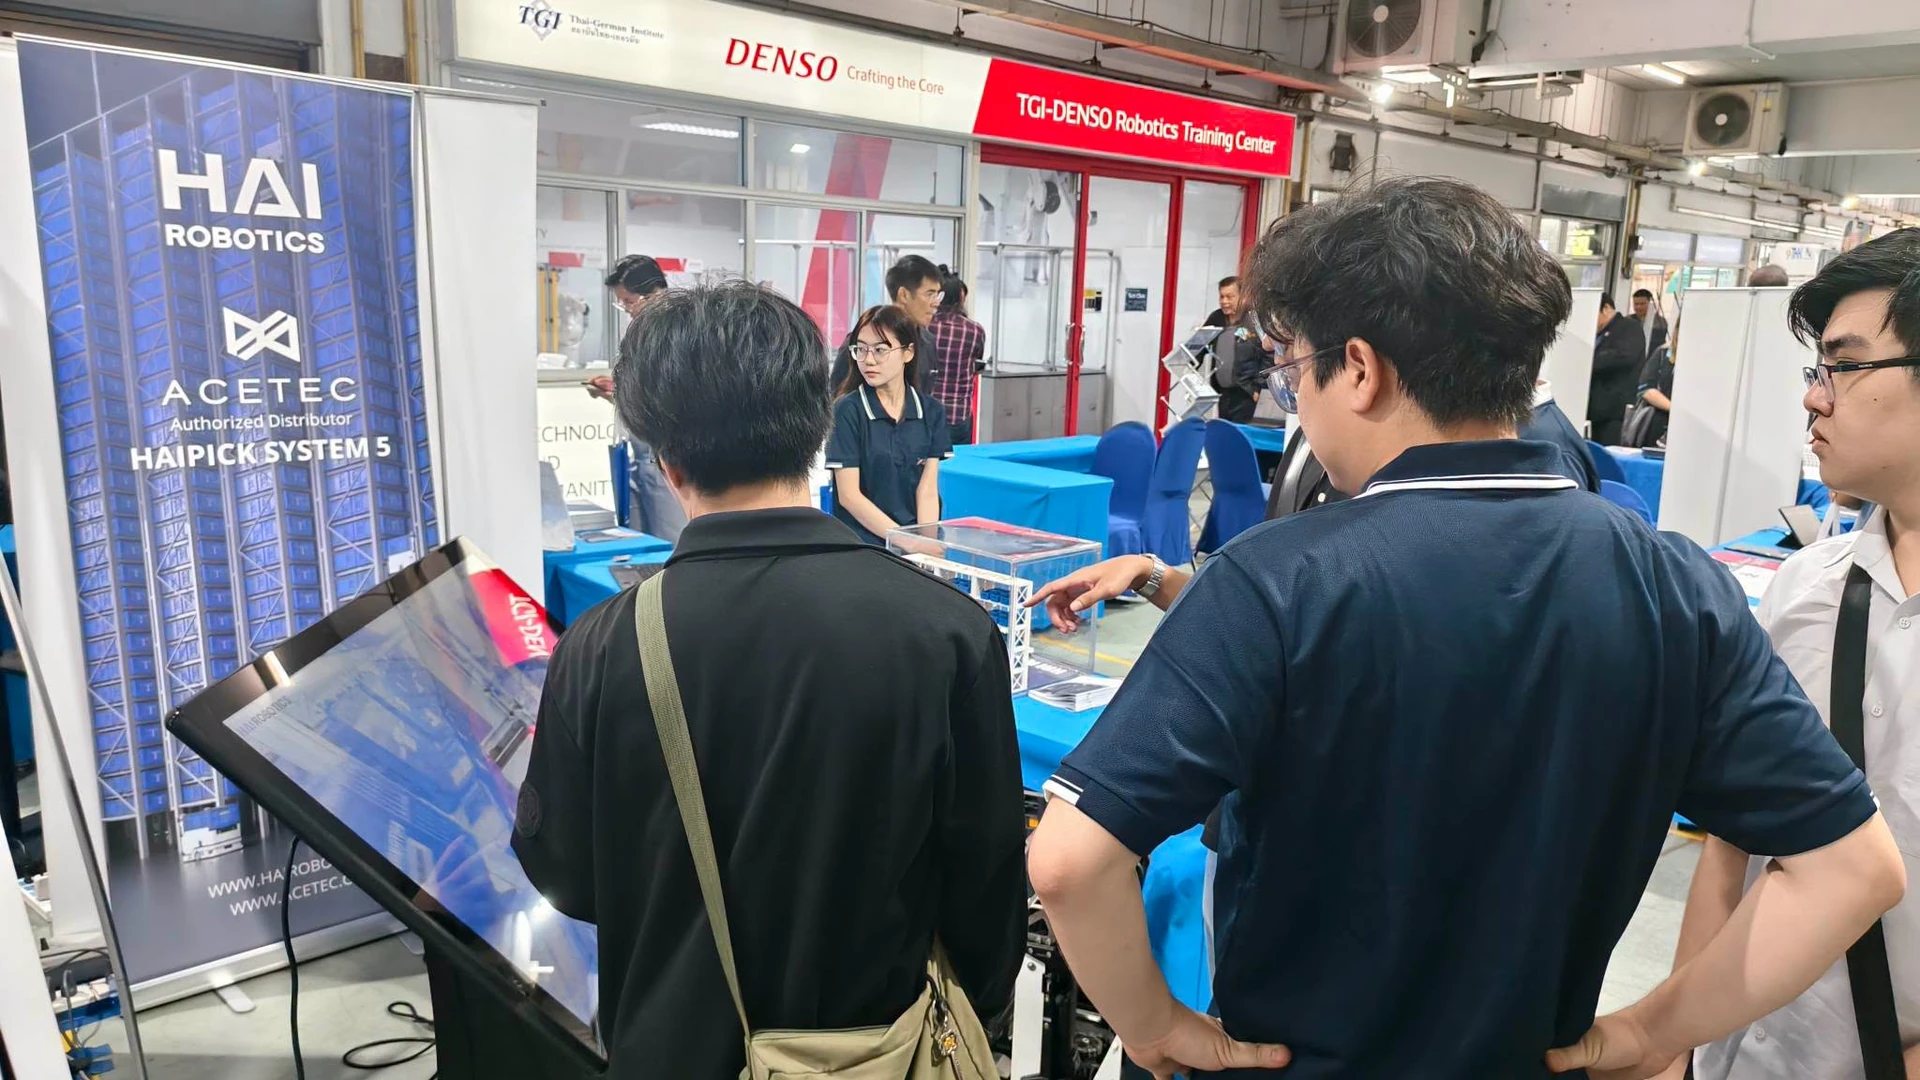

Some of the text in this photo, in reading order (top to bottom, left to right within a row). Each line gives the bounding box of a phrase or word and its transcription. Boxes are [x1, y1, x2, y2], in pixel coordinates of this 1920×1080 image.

[519, 5, 562, 30] TGI
[569, 14, 628, 33] Thai-German
[725, 38, 945, 96] DENSO Crafting the Core
[1016, 93, 1277, 156] TGI-DENSO Robotics Training Center
[158, 148, 323, 220] HAI
[164, 223, 326, 255] ROBOTICS
[161, 377, 357, 406] ACETEC
[170, 412, 353, 432] Authorized Distributor
[130, 435, 392, 472] HAIPICK SYSTEM 5
